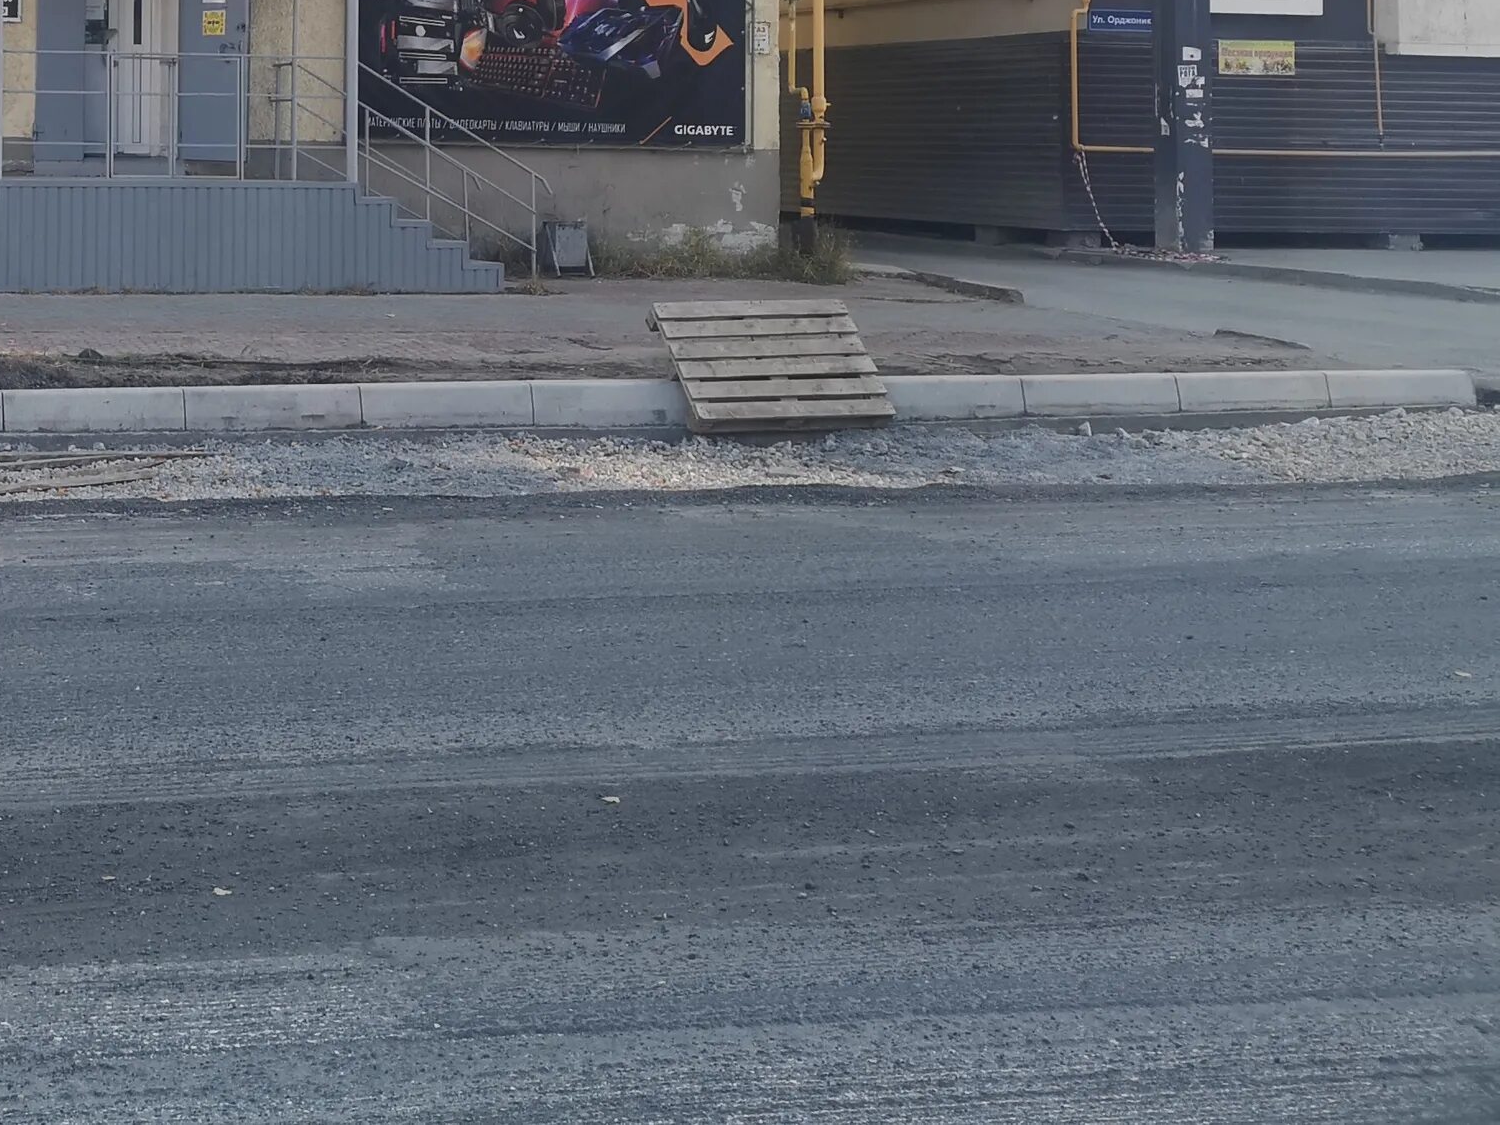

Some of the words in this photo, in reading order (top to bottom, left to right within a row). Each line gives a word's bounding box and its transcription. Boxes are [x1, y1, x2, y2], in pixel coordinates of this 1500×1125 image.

[1092, 15, 1105, 24] Ул.
[505, 120, 550, 132] КЛАВИАТУРЫ
[558, 122, 580, 132] МЫШИ
[588, 122, 626, 133] НАУШНИКИ
[674, 124, 734, 136] GIGABYTE
